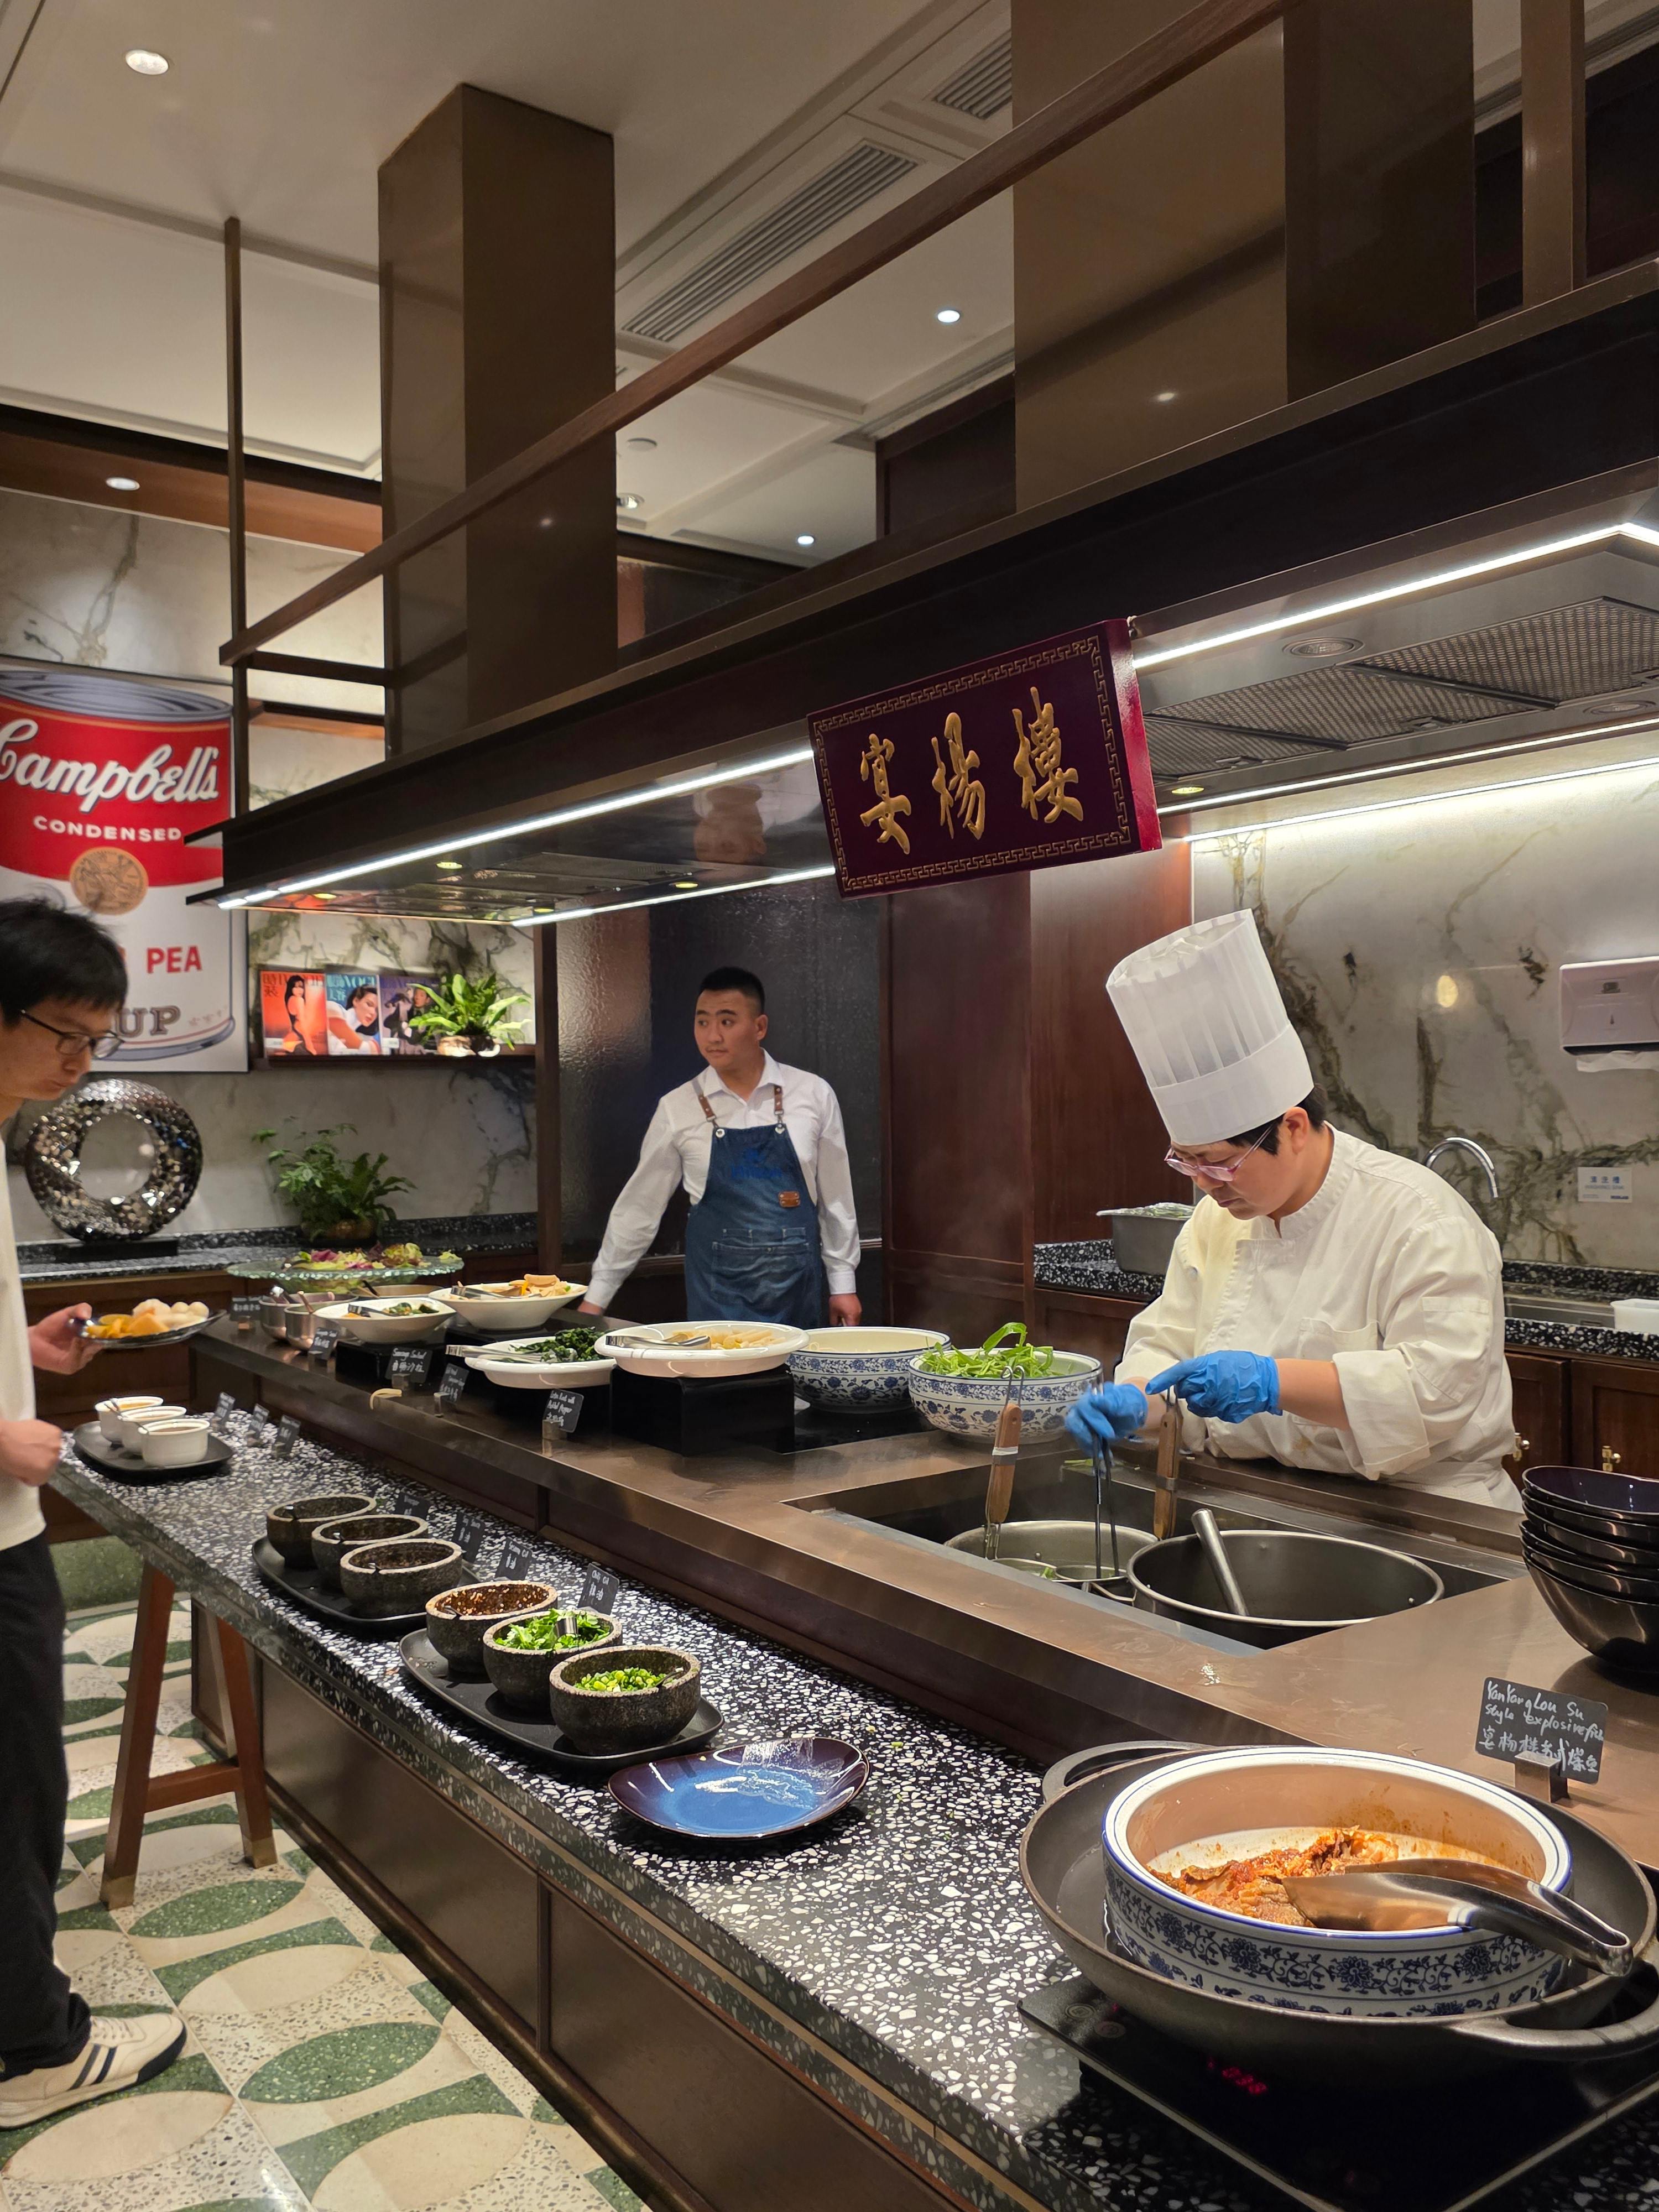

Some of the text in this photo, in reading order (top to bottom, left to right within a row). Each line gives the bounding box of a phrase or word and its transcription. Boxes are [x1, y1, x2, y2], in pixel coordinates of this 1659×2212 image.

[33, 815, 182, 842] CONDENSED
[147, 945, 203, 974] PEA
[115, 1005, 181, 1037] UP
[1566, 1702, 1584, 1720] Su
